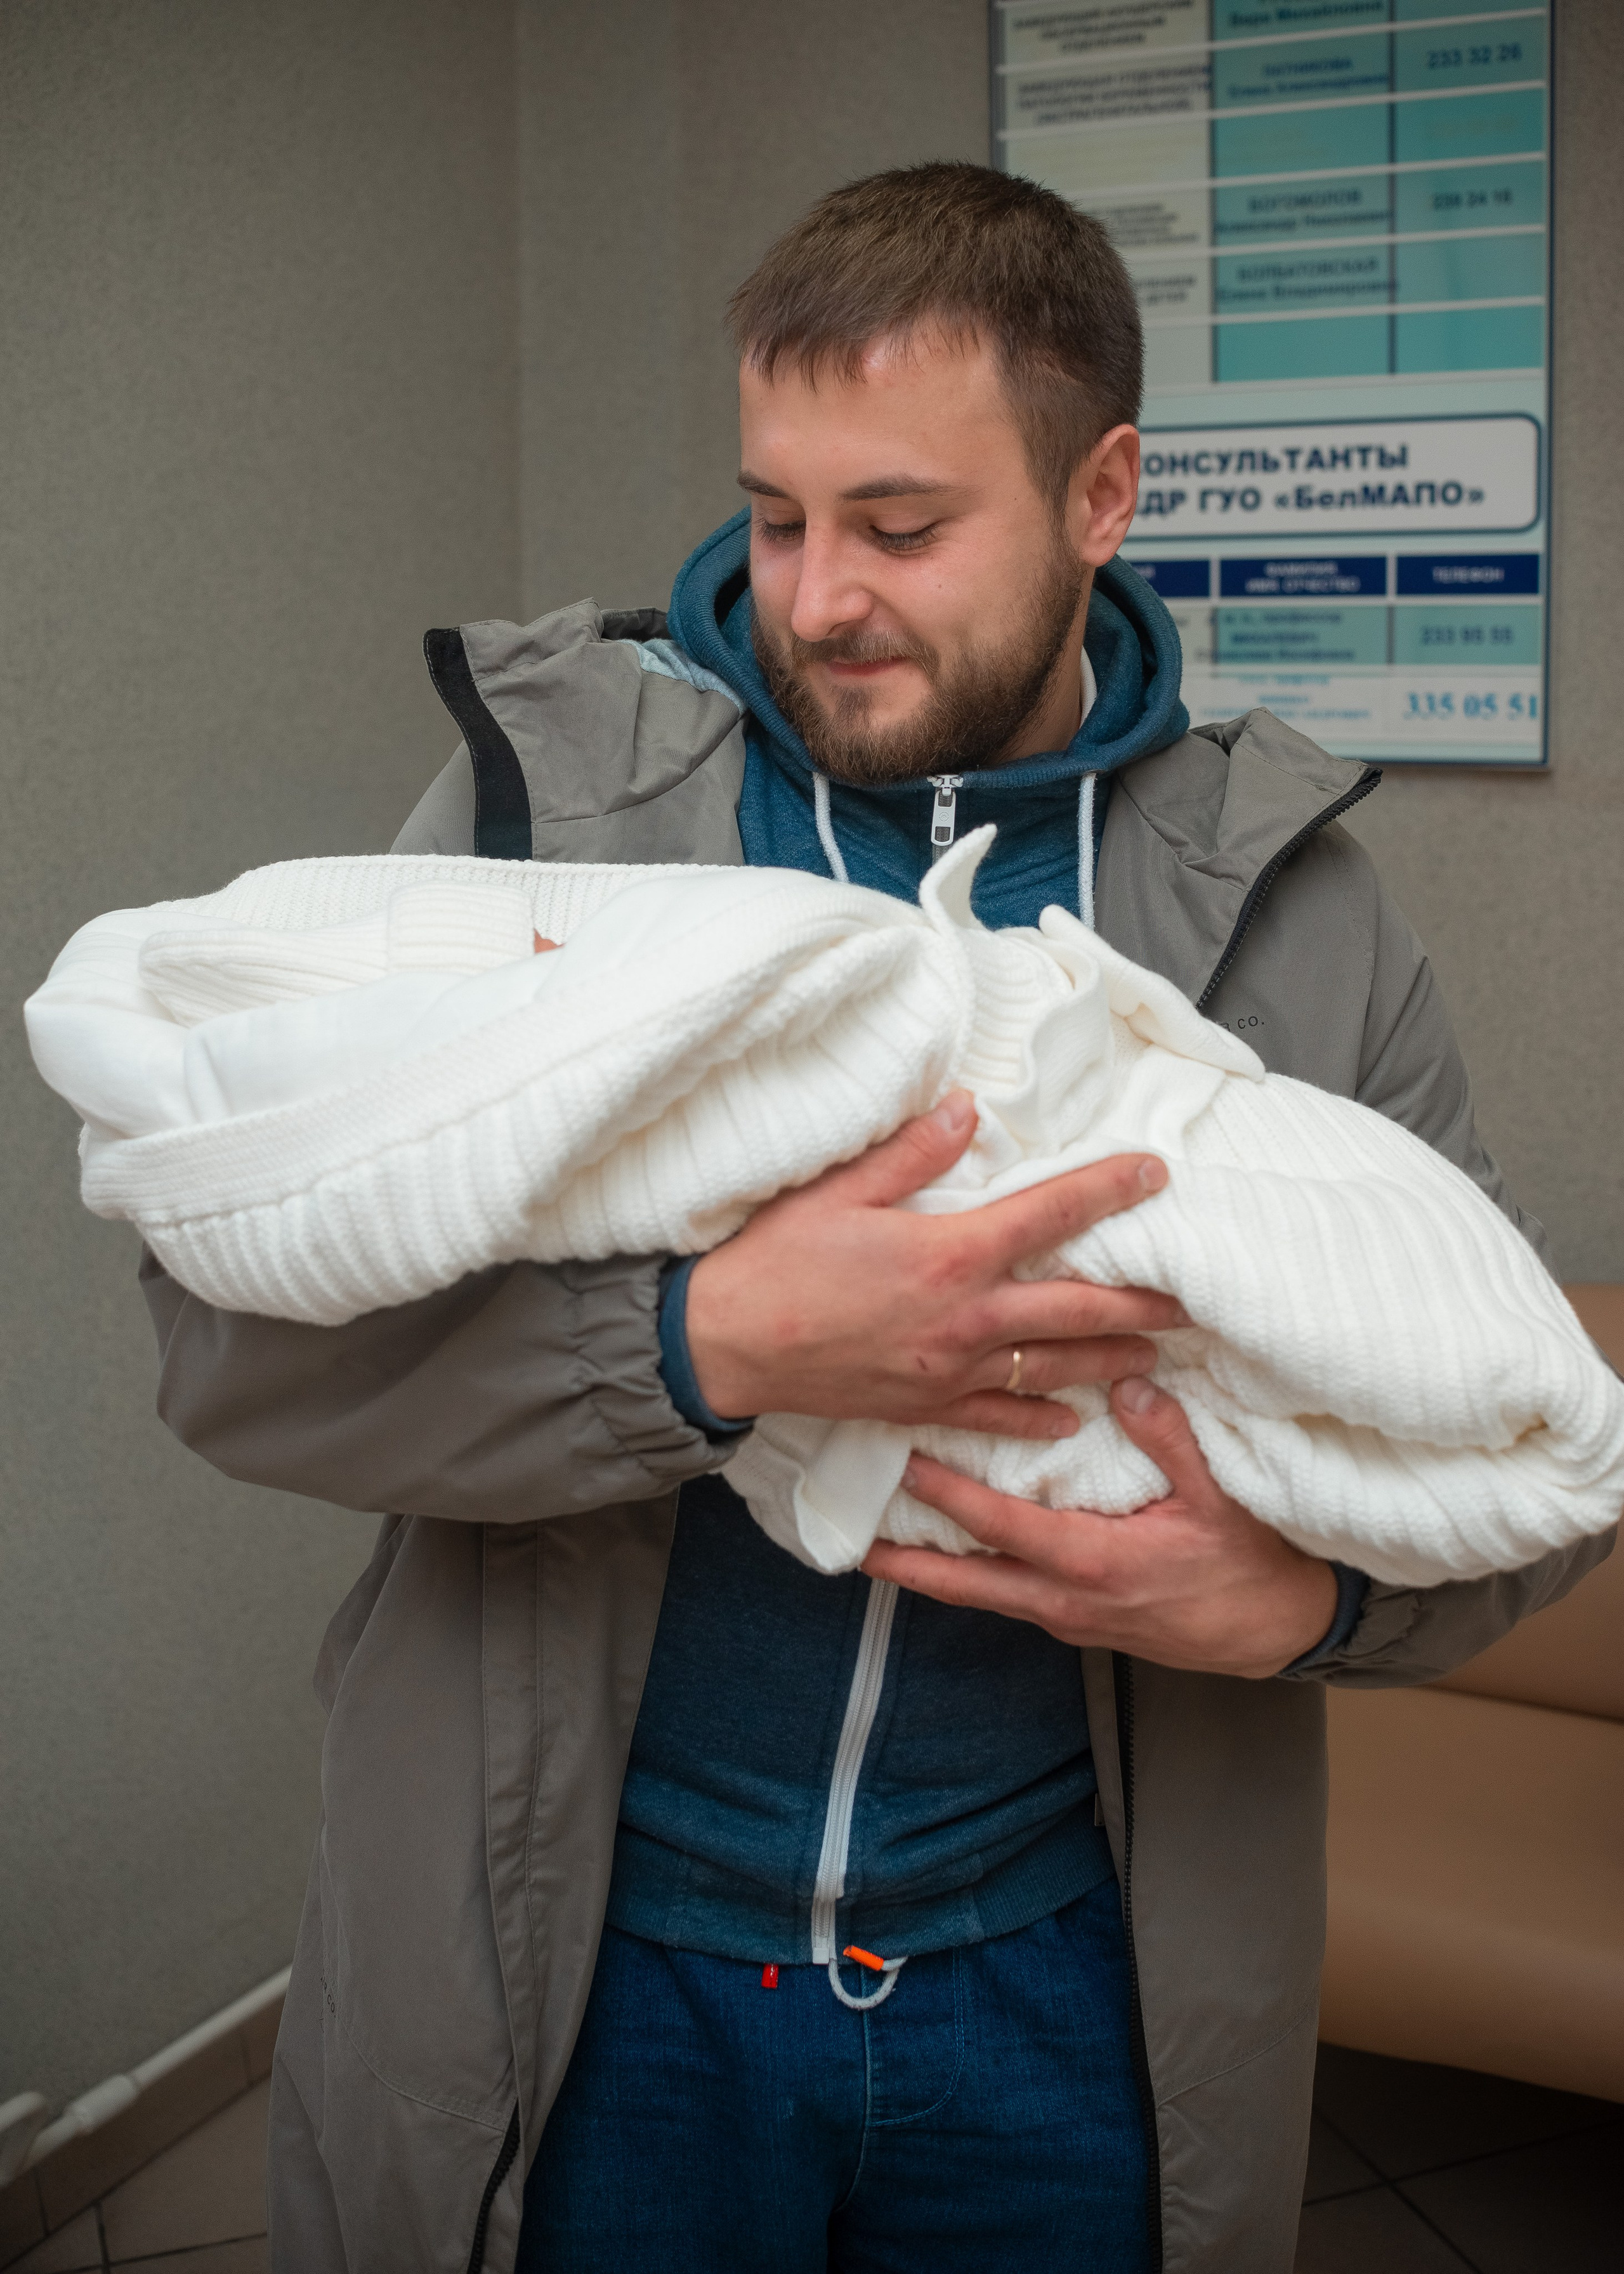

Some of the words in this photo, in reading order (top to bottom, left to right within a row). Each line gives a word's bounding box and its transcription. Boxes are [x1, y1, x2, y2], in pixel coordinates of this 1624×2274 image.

[1139, 445, 1408, 476] ОНСУЛЬТАНТЫ
[1137, 488, 1187, 519] ДР
[1199, 487, 1262, 513] ГУО
[1273, 480, 1484, 513] «БелМАПО»
[1403, 693, 1455, 719] 335
[1462, 695, 1498, 719] 05
[1507, 695, 1538, 719] 51
[1237, 1016, 1265, 1029] CO.
